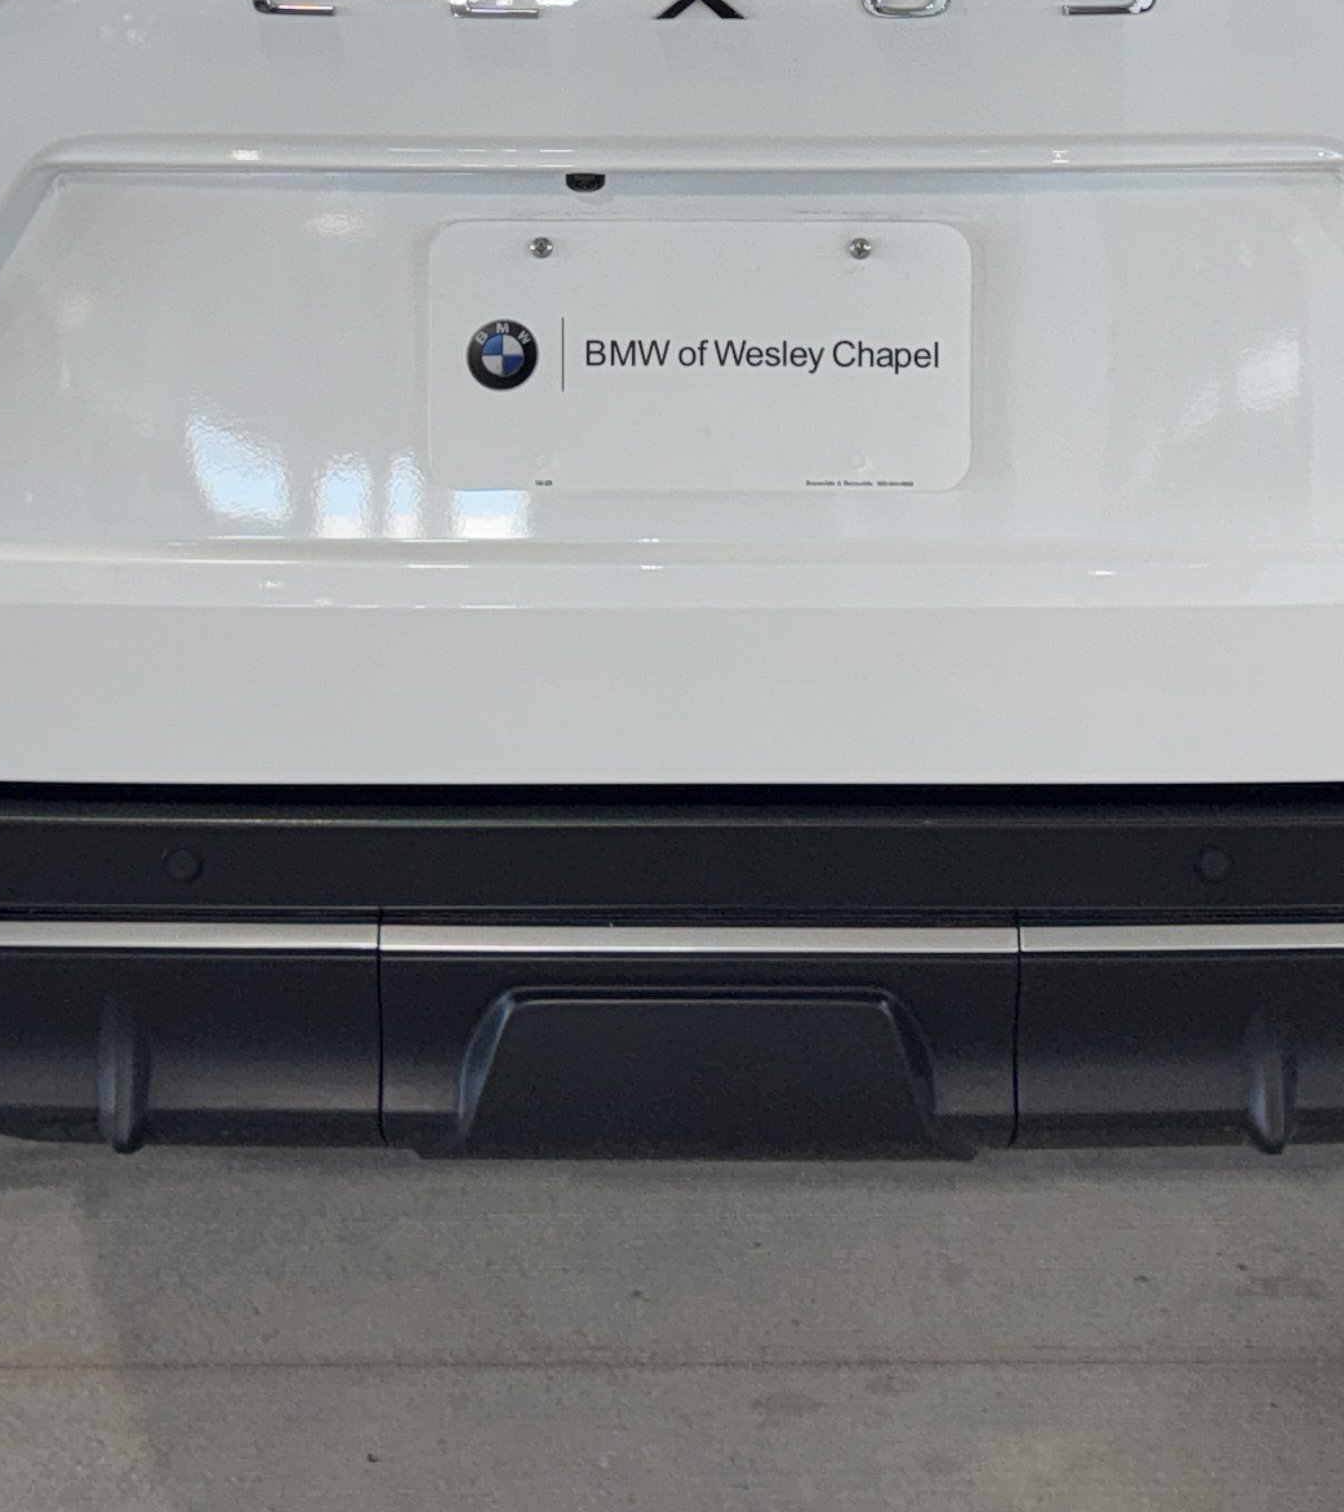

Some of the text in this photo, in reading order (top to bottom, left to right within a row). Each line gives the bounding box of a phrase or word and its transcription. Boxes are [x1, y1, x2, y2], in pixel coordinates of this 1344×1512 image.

[474, 322, 532, 345] BMW
[585, 339, 940, 375] BMW of Wesley Chapel
